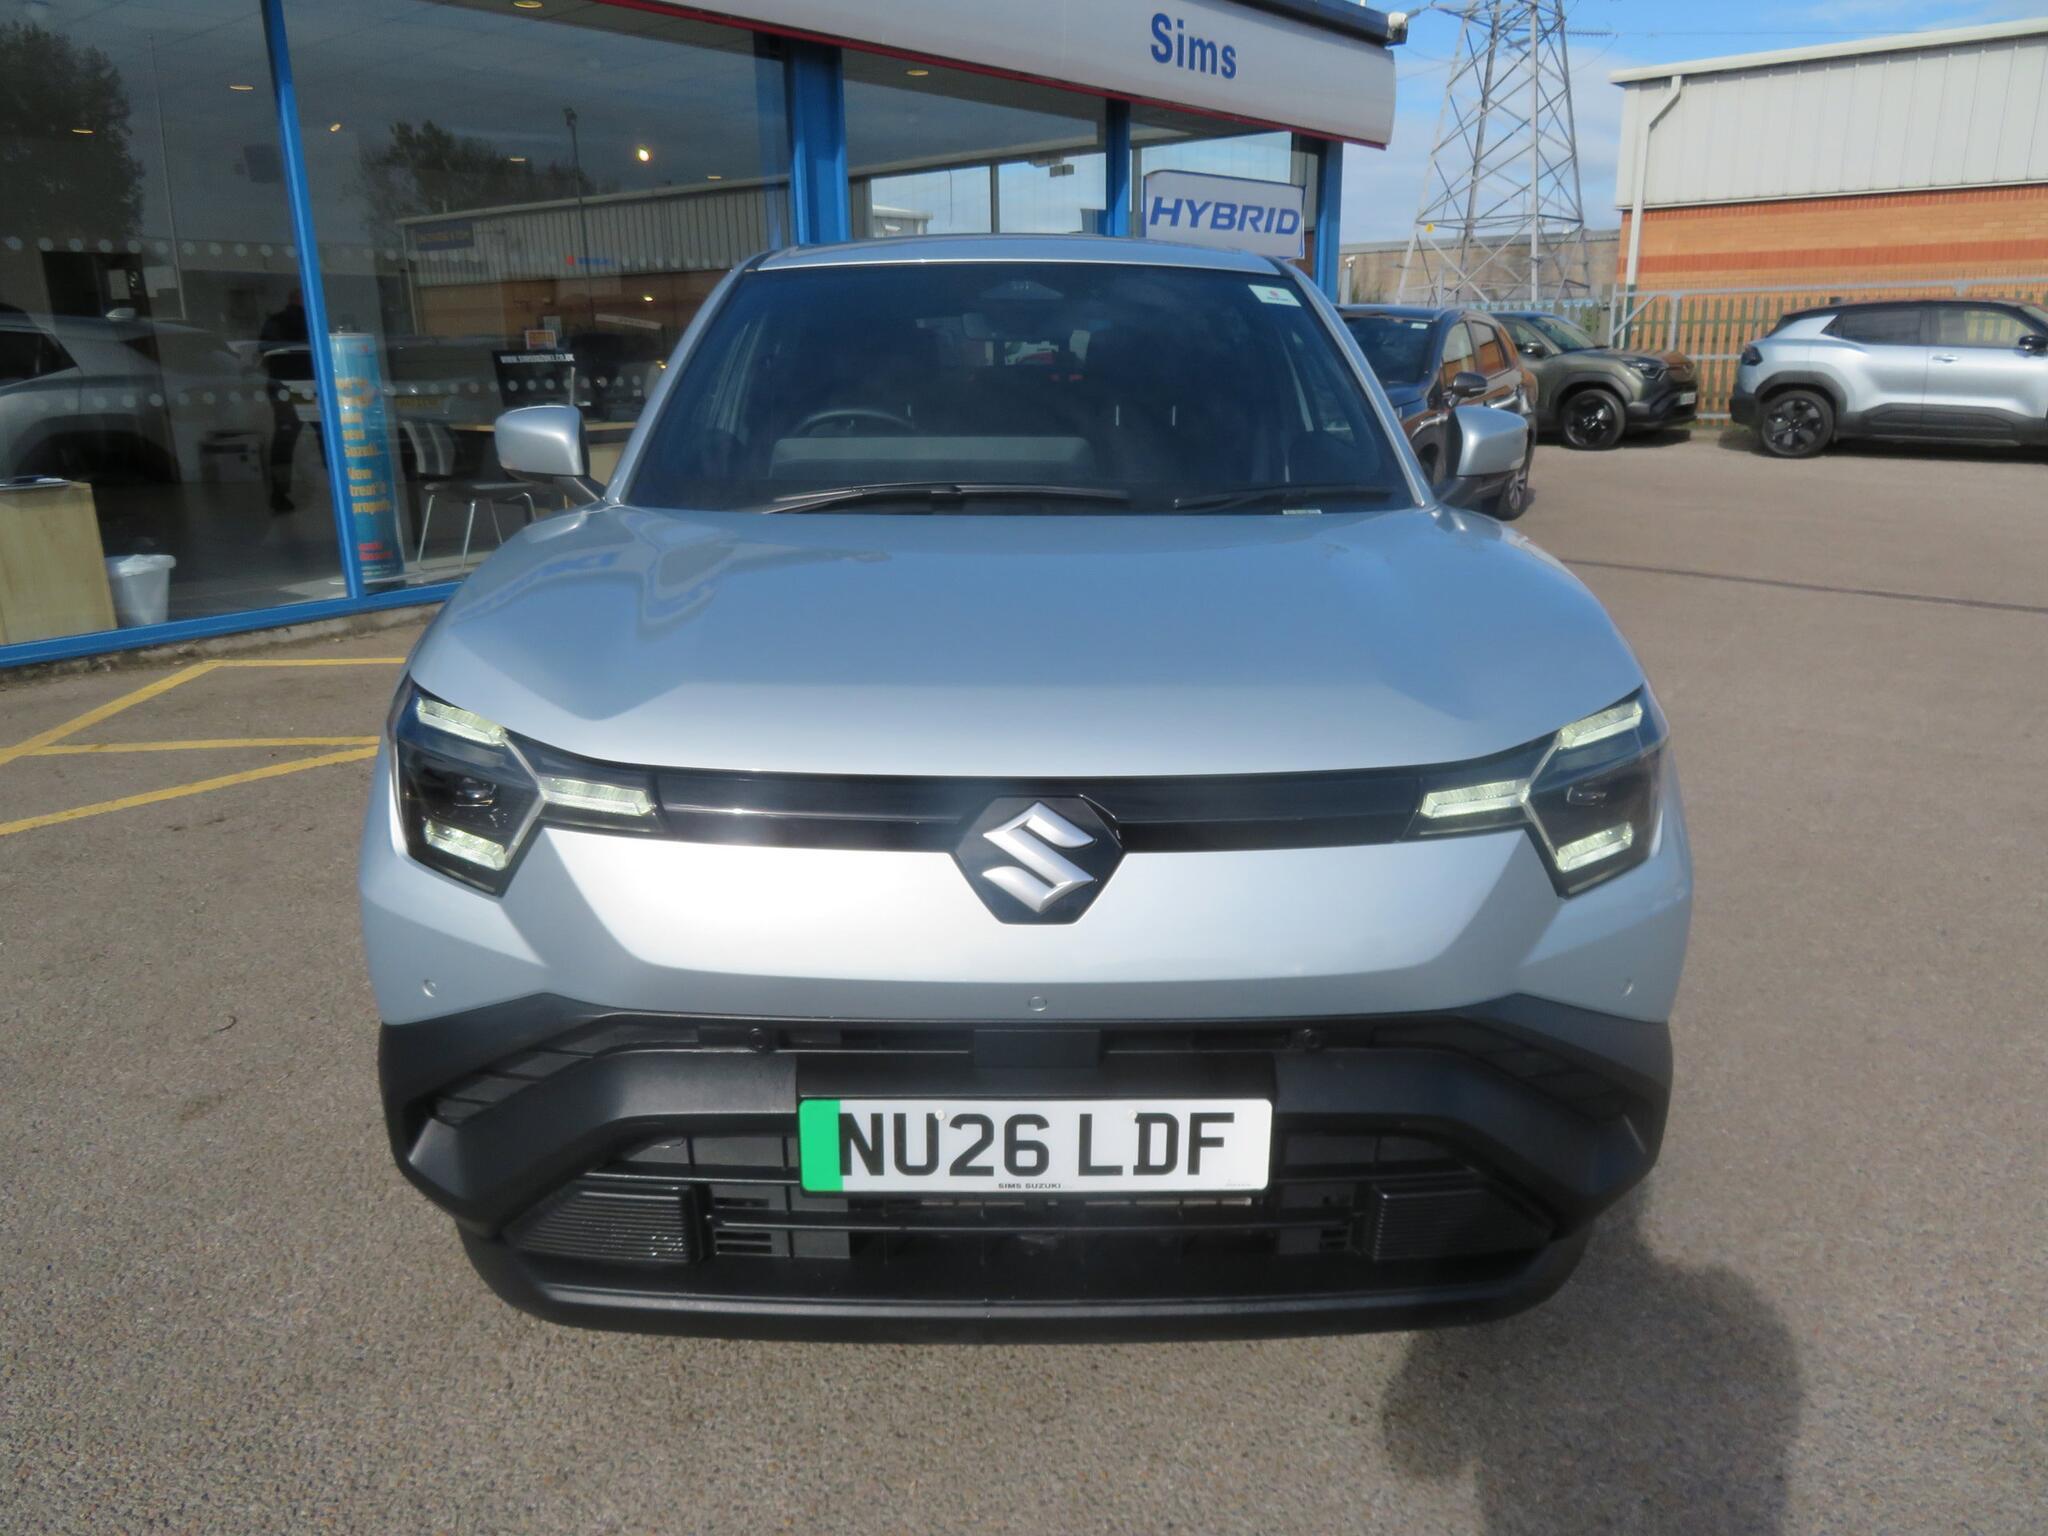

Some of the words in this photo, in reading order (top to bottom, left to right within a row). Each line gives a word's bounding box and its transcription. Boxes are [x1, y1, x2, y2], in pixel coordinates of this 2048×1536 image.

[1150, 12, 1237, 80] Sims
[1150, 196, 1300, 236] HYBRID
[837, 1112, 1050, 1177] NU26
[1078, 1112, 1235, 1177] LDF
[998, 1182, 1022, 1190] SIMS
[1025, 1182, 1062, 1190] SUZUKI
